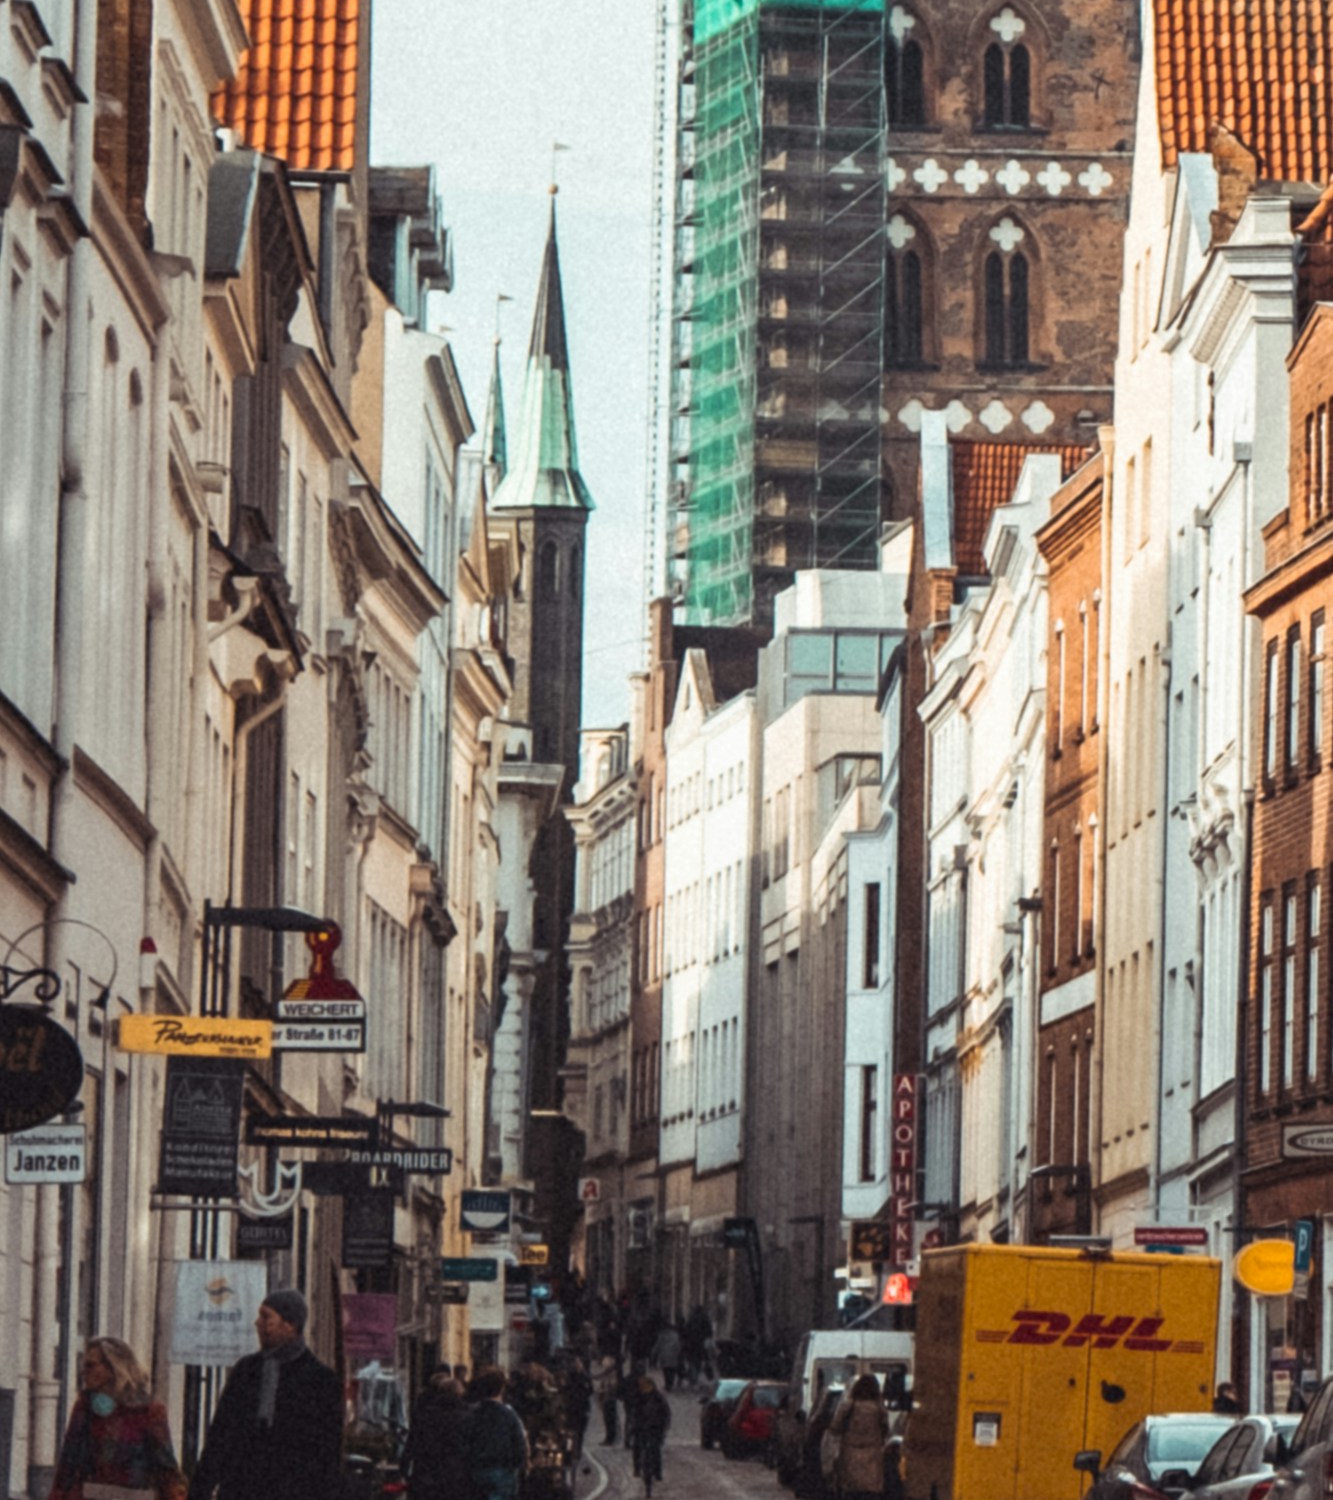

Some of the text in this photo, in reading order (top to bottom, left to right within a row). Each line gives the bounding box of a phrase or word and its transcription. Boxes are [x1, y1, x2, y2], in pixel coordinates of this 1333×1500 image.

[284, 1003, 358, 1016] WEICHERT
[286, 1028, 324, 1041] Straße
[13, 1149, 80, 1172] Janzen
[894, 1076, 912, 1265] APOTHEKE
[1007, 1310, 1173, 1351] DHL
